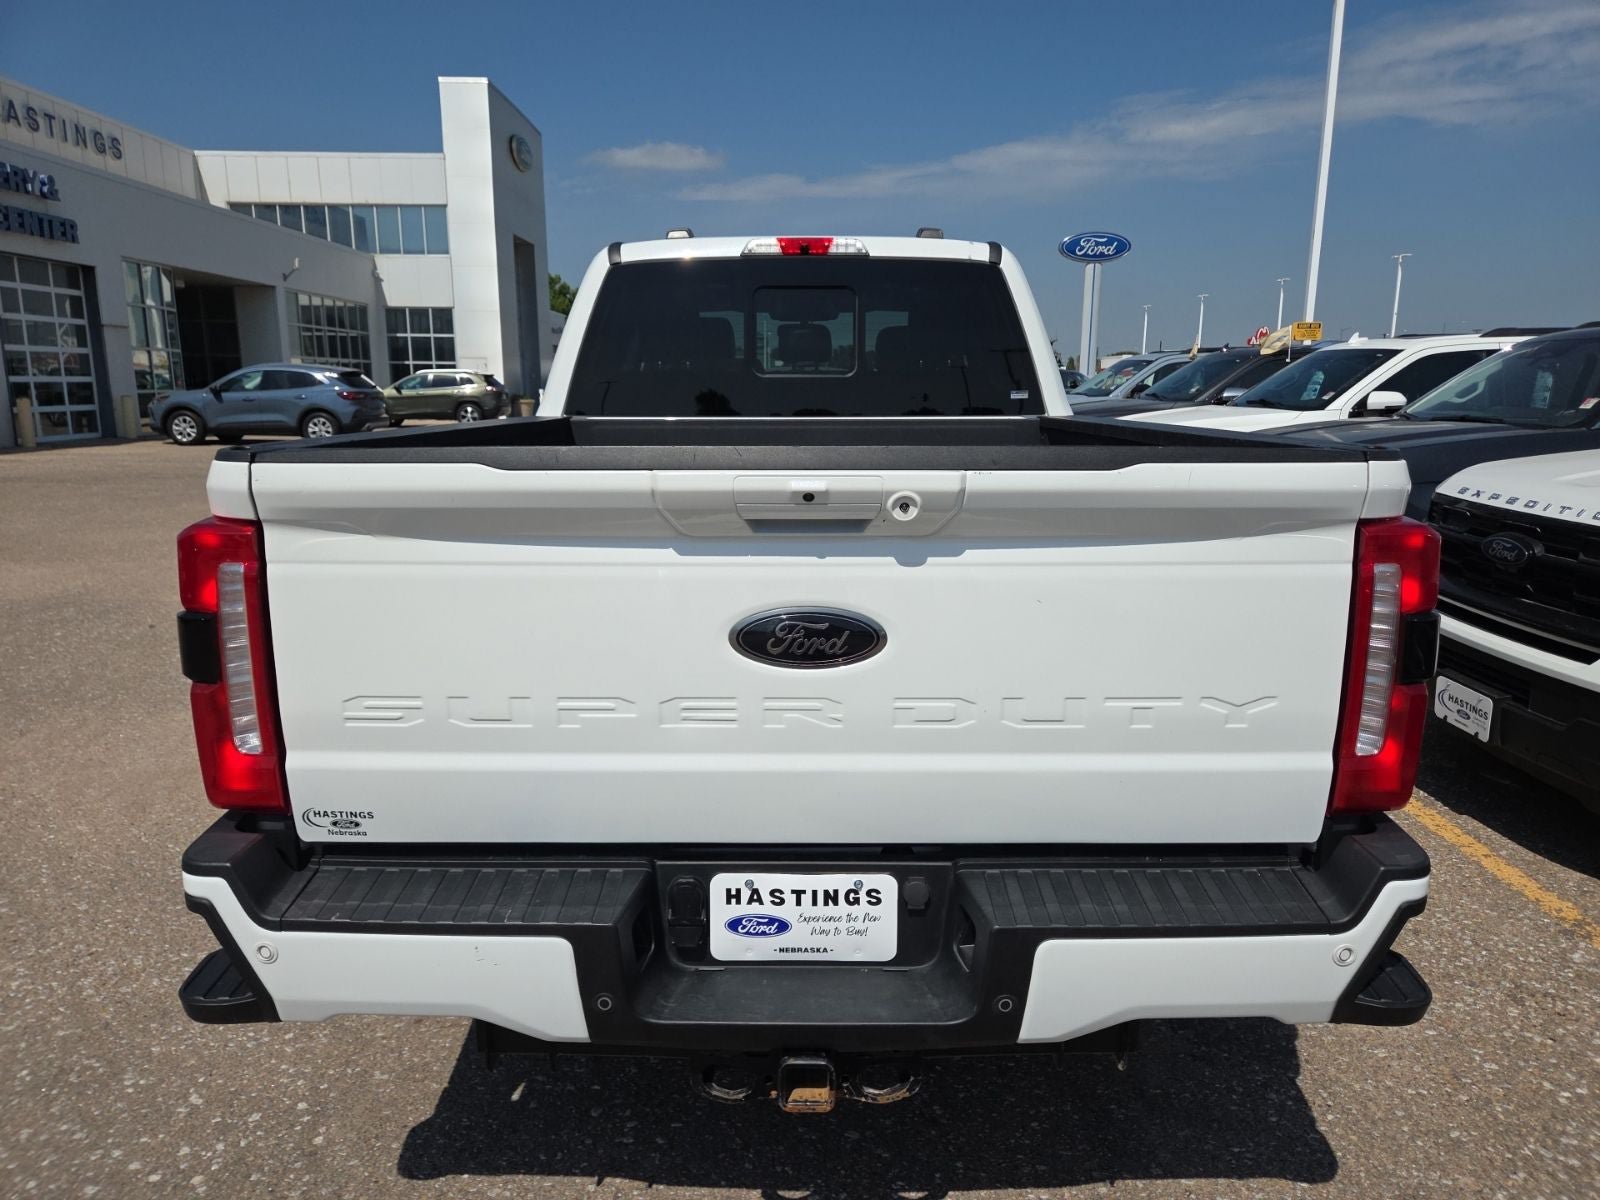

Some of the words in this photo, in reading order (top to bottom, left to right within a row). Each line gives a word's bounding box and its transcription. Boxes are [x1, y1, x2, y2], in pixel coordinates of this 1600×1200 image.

[7, 99, 123, 161] ASTINGS
[1075, 236, 1118, 256] Ford
[1488, 540, 1520, 561] Ford
[766, 620, 851, 656] Ford
[342, 696, 843, 728] SUPER
[893, 696, 1279, 728] DUTY
[1448, 692, 1489, 721] HASTINGS
[313, 810, 375, 819] HASTINGS
[327, 829, 368, 837] Nebraska
[725, 887, 883, 907] HASTINGS
[737, 917, 778, 935] Ford
[797, 912, 843, 925] Experience
[845, 912, 859, 924] the
[862, 912, 881, 924] New
[810, 925, 831, 937] Way
[833, 926, 842, 937] to
[845, 925, 869, 937] Buy!
